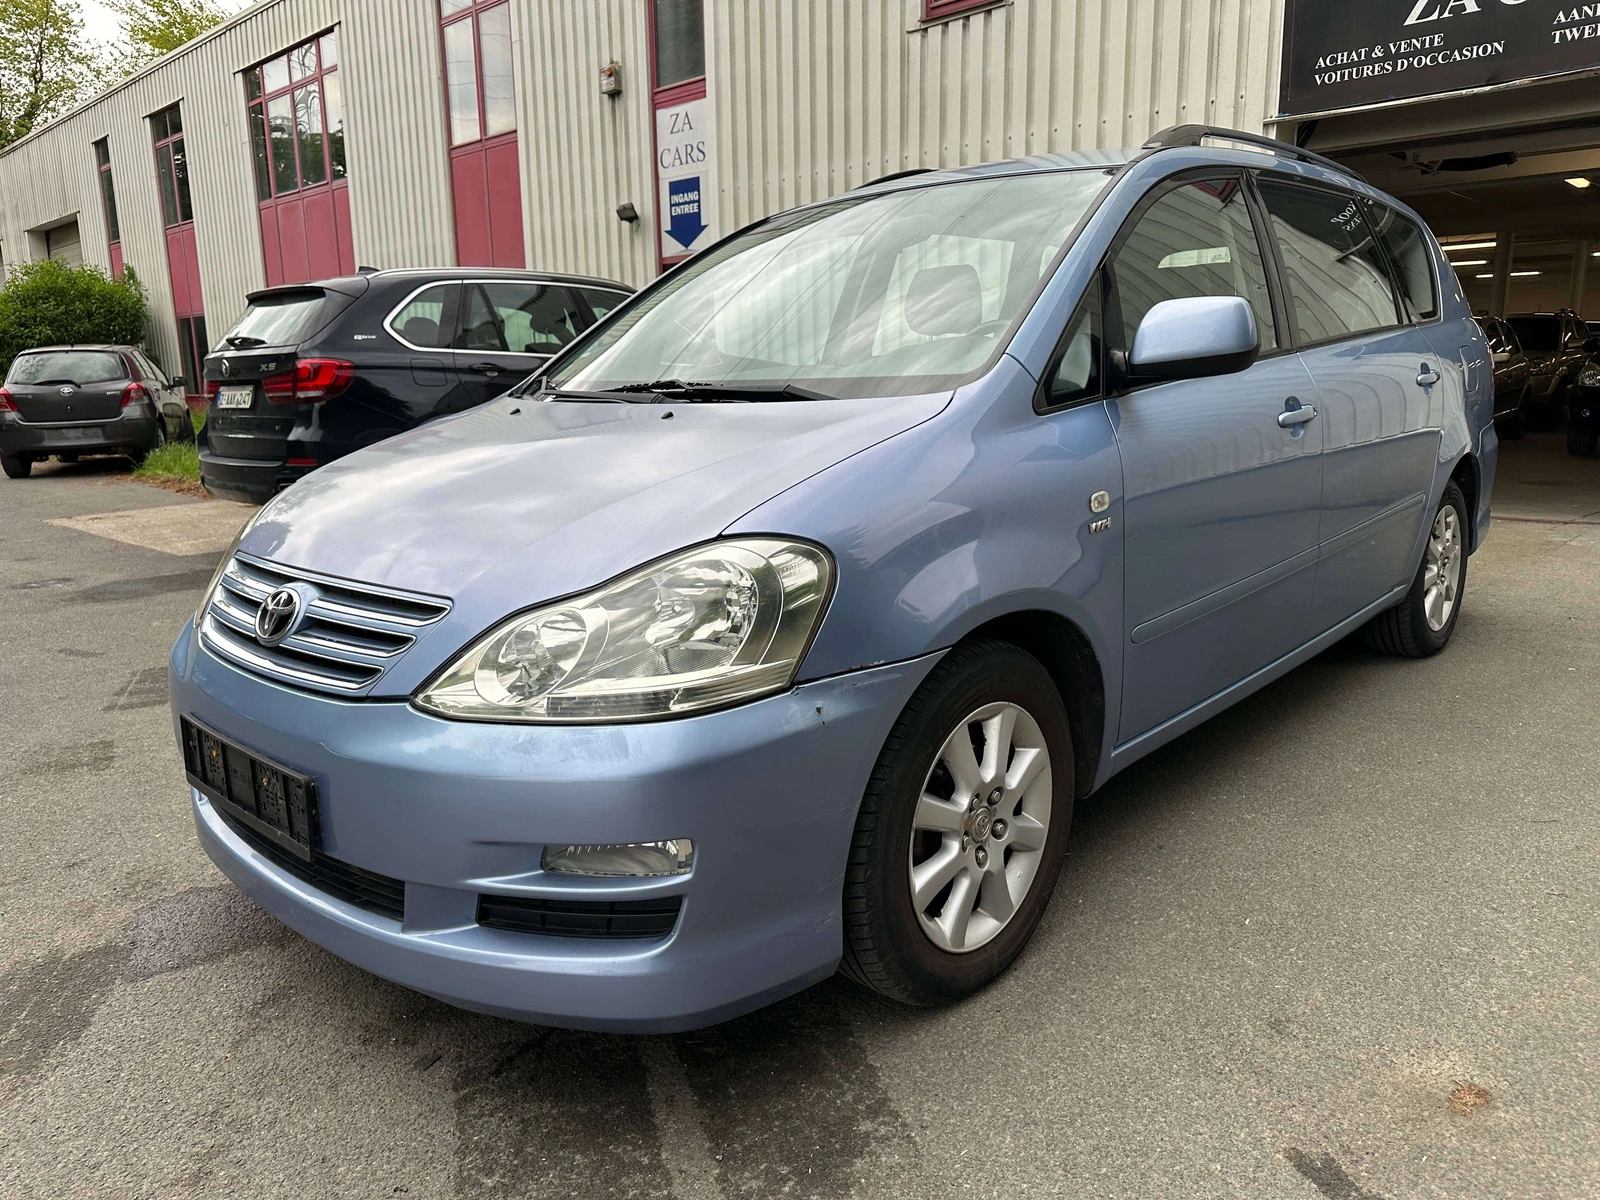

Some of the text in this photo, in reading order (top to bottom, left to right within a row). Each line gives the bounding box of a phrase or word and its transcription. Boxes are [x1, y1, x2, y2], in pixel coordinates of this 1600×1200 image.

[1314, 33, 1445, 69] ACHAT & VENTE
[1314, 40, 1505, 86] VOITURES D'OCCASION
[670, 111, 693, 135] ZA
[660, 141, 706, 169] CARS
[671, 191, 698, 204] INGANG
[671, 203, 698, 215] ENTREE
[259, 362, 277, 372] X5
